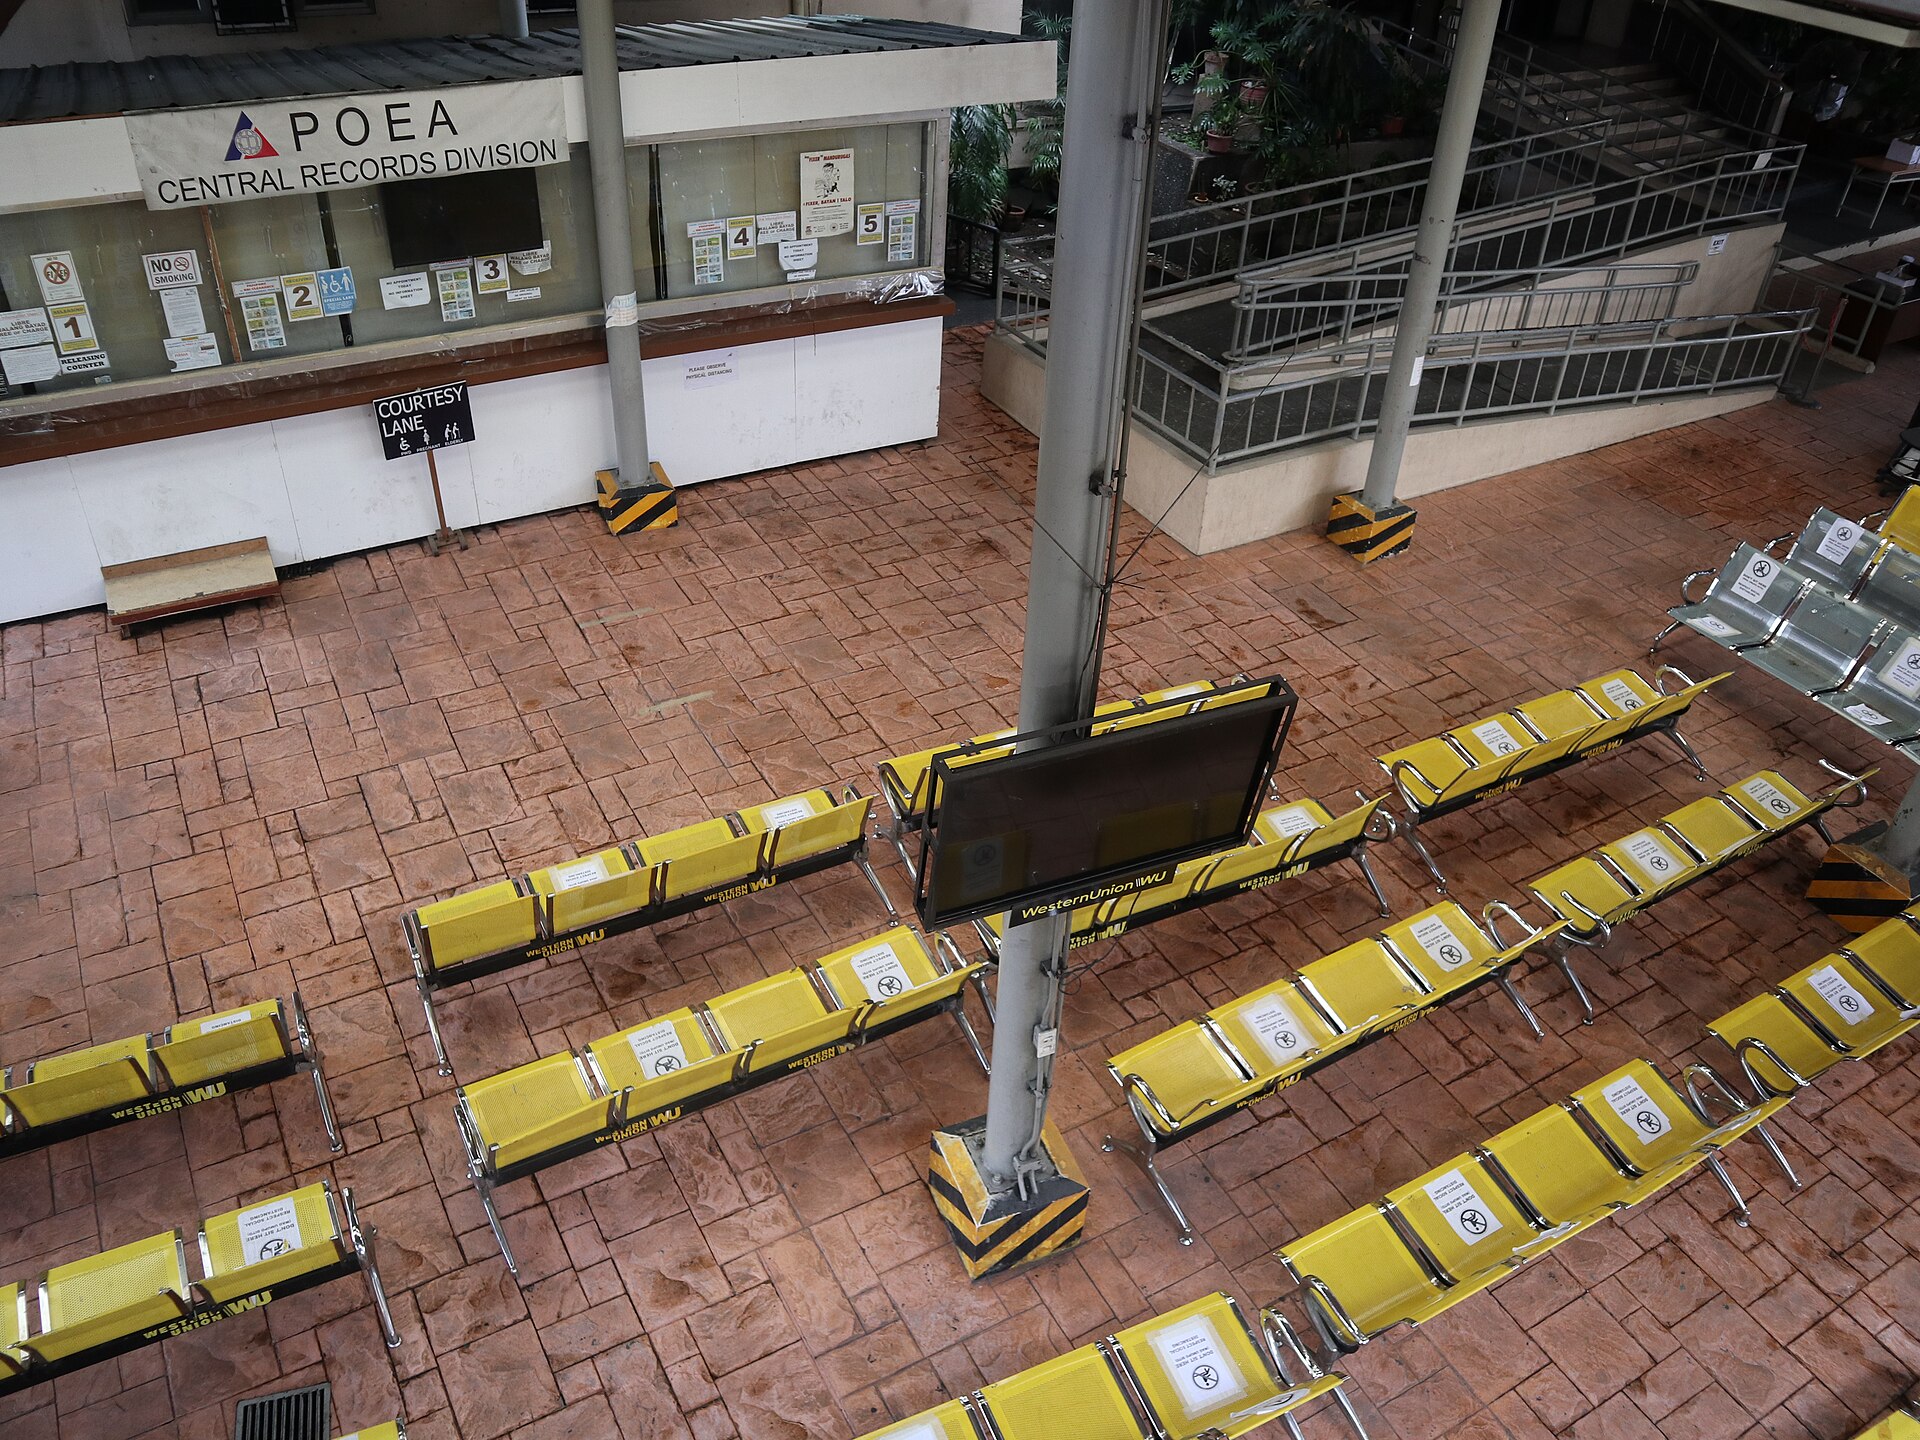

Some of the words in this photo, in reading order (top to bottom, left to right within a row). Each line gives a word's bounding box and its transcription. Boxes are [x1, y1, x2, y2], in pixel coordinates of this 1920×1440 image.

[288, 100, 458, 152] POEA
[158, 168, 294, 204] CENTRAL
[302, 151, 436, 188] RECORDS
[444, 139, 557, 172] DIVISION
[864, 215, 877, 232] 5
[734, 227, 749, 246] 4
[151, 258, 172, 273] NO
[484, 259, 500, 280] 3
[154, 272, 194, 284] SMOKING
[292, 286, 313, 308] 2
[64, 317, 82, 338] 1
[61, 353, 106, 365] RELEASING
[67, 362, 105, 371] COUNTER
[706, 362, 726, 370] OBSERVE
[686, 372, 706, 380] PHYSICAL
[708, 369, 732, 377] DISTANCING
[378, 385, 463, 418] COURTESY
[382, 414, 424, 438] LANE
[416, 443, 441, 452] PREGNANT
[445, 438, 464, 446] ELDERLY
[1286, 861, 1310, 878] WU
[751, 875, 776, 891] WU
[1138, 870, 1167, 886] WU
[1251, 875, 1280, 890] UNION
[703, 884, 747, 902] WESTERN
[719, 889, 748, 903] UNION
[577, 928, 605, 946] WU
[526, 938, 573, 958] WESTERN
[1069, 937, 1095, 950] NION
[542, 944, 575, 958] UNION
[860, 951, 885, 963] DISTANCING
[857, 960, 872, 968] SOCIAL
[873, 954, 891, 963] RESPECT
[885, 964, 898, 972] DON'T
[863, 972, 875, 980] HERE
[211, 1018, 242, 1029] DISTANCING
[638, 1029, 665, 1041] DISTANCING
[653, 1032, 672, 1041] RESPECT
[634, 1038, 651, 1048] SOCIAL
[664, 1042, 679, 1051] DON'T
[640, 1051, 654, 1060] HERE
[654, 1047, 663, 1055] SIT
[788, 1046, 835, 1069] WESTERN
[803, 1053, 835, 1068] UNION
[1277, 1072, 1304, 1091] WU
[187, 1082, 227, 1103] WU
[1611, 1085, 1631, 1097] DISTANCING
[1625, 1087, 1638, 1097] RESPECT
[1611, 1094, 1624, 1103] SOCIAL
[1637, 1098, 1649, 1108] DON'T
[111, 1096, 180, 1119] WESTERN
[136, 1101, 182, 1119] UNION
[1620, 1107, 1630, 1116] HERE
[651, 1106, 681, 1126] WU
[612, 1125, 648, 1141] UNION
[1434, 1180, 1457, 1195] DISTANCING
[1449, 1182, 1465, 1193] RESPECT
[1433, 1191, 1448, 1201] SOCIAL
[1462, 1194, 1475, 1205] DON'T
[250, 1207, 284, 1221] DISTANCING
[266, 1210, 291, 1221] RESPECT
[1442, 1205, 1455, 1214] HERE
[245, 1217, 264, 1227] SOCIAL
[277, 1223, 294, 1233] DON'T
[246, 1234, 263, 1242] HERE
[265, 1229, 274, 1237] SIT
[228, 1290, 272, 1314] WU
[170, 1312, 223, 1336] UNION
[1172, 1335, 1199, 1348] DISTANCING
[1186, 1338, 1206, 1349] RESPECT
[1169, 1345, 1186, 1354] SOCIAL
[1199, 1350, 1214, 1360] DON'T
[1176, 1360, 1190, 1369] HERE
